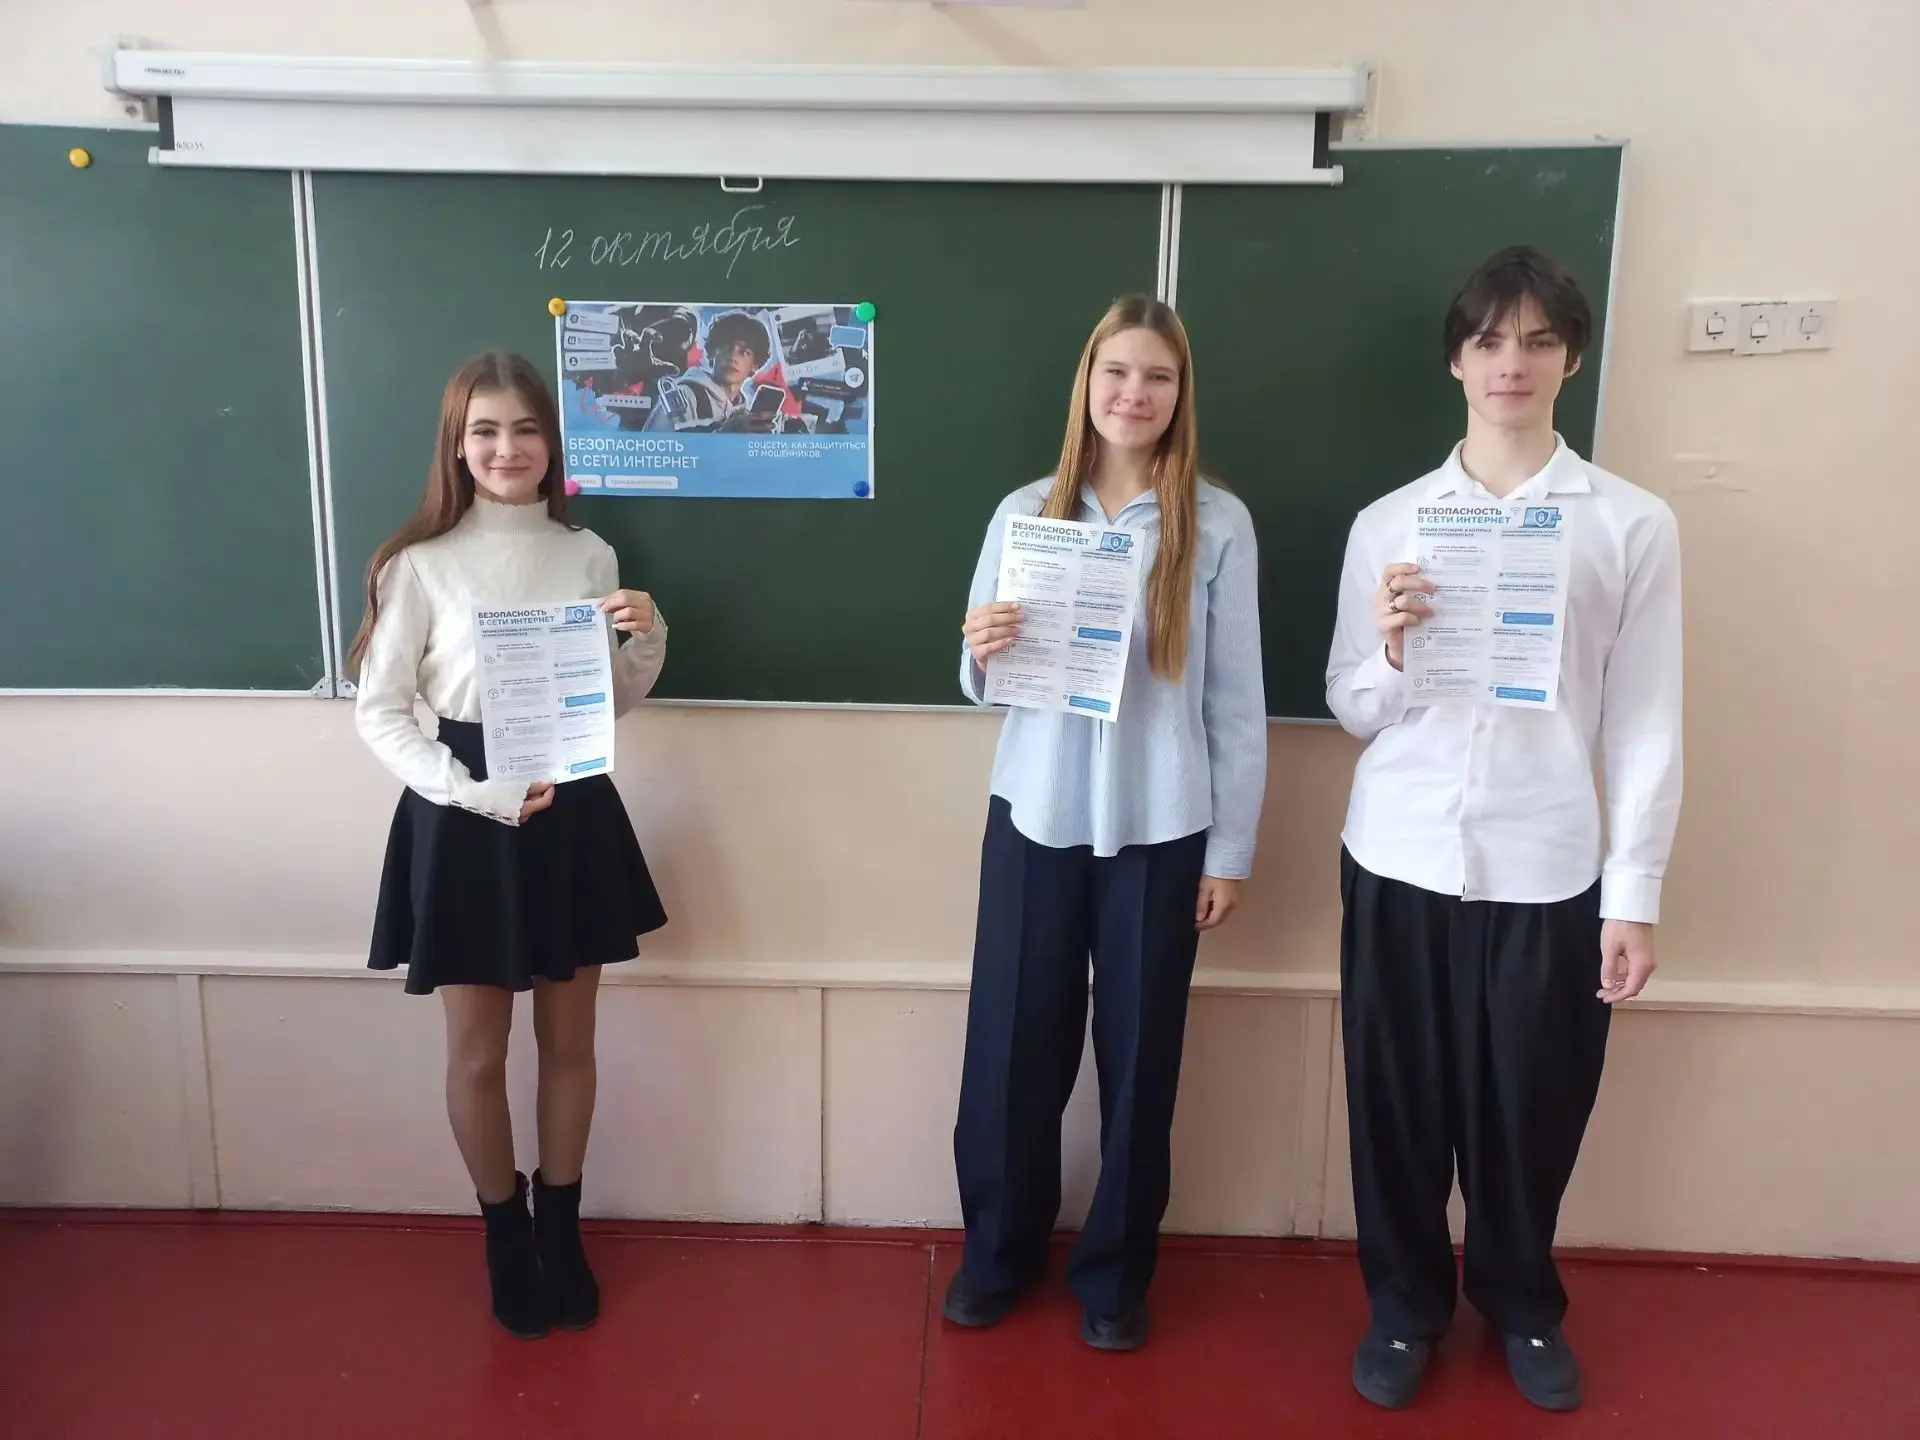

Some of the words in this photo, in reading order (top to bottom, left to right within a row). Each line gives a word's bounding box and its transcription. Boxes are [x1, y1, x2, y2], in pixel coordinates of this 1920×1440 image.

[535, 227, 574, 269] 12
[591, 205, 800, 279] октября
[568, 437, 684, 453] БЕЗОПАСНОСТЬ
[791, 441, 808, 449] КАК
[809, 441, 866, 451] ЗАЩИТИТЬСЯ
[748, 449, 759, 457] ОТ
[569, 454, 580, 467] В
[582, 455, 620, 468] СЕТИ
[623, 456, 699, 469] ИНТЕРНЕТ
[1418, 507, 1502, 516] БЕЗОПАСНОСТЬ
[1417, 516, 1424, 524] В
[1427, 516, 1454, 524] СЕТИ
[1456, 516, 1511, 524] ИНТЕРНЕТ
[1012, 522, 1083, 537] БЕЗОПАСНОСТЬ
[1019, 530, 1042, 539] СЕТИ
[1043, 533, 1090, 546] ИНТЕРНЕТ
[478, 610, 547, 619] БЕЗОПАСНОСТЬ
[486, 618, 509, 626] СЕТИ
[510, 616, 555, 624] ИНТЕРНЕТ
